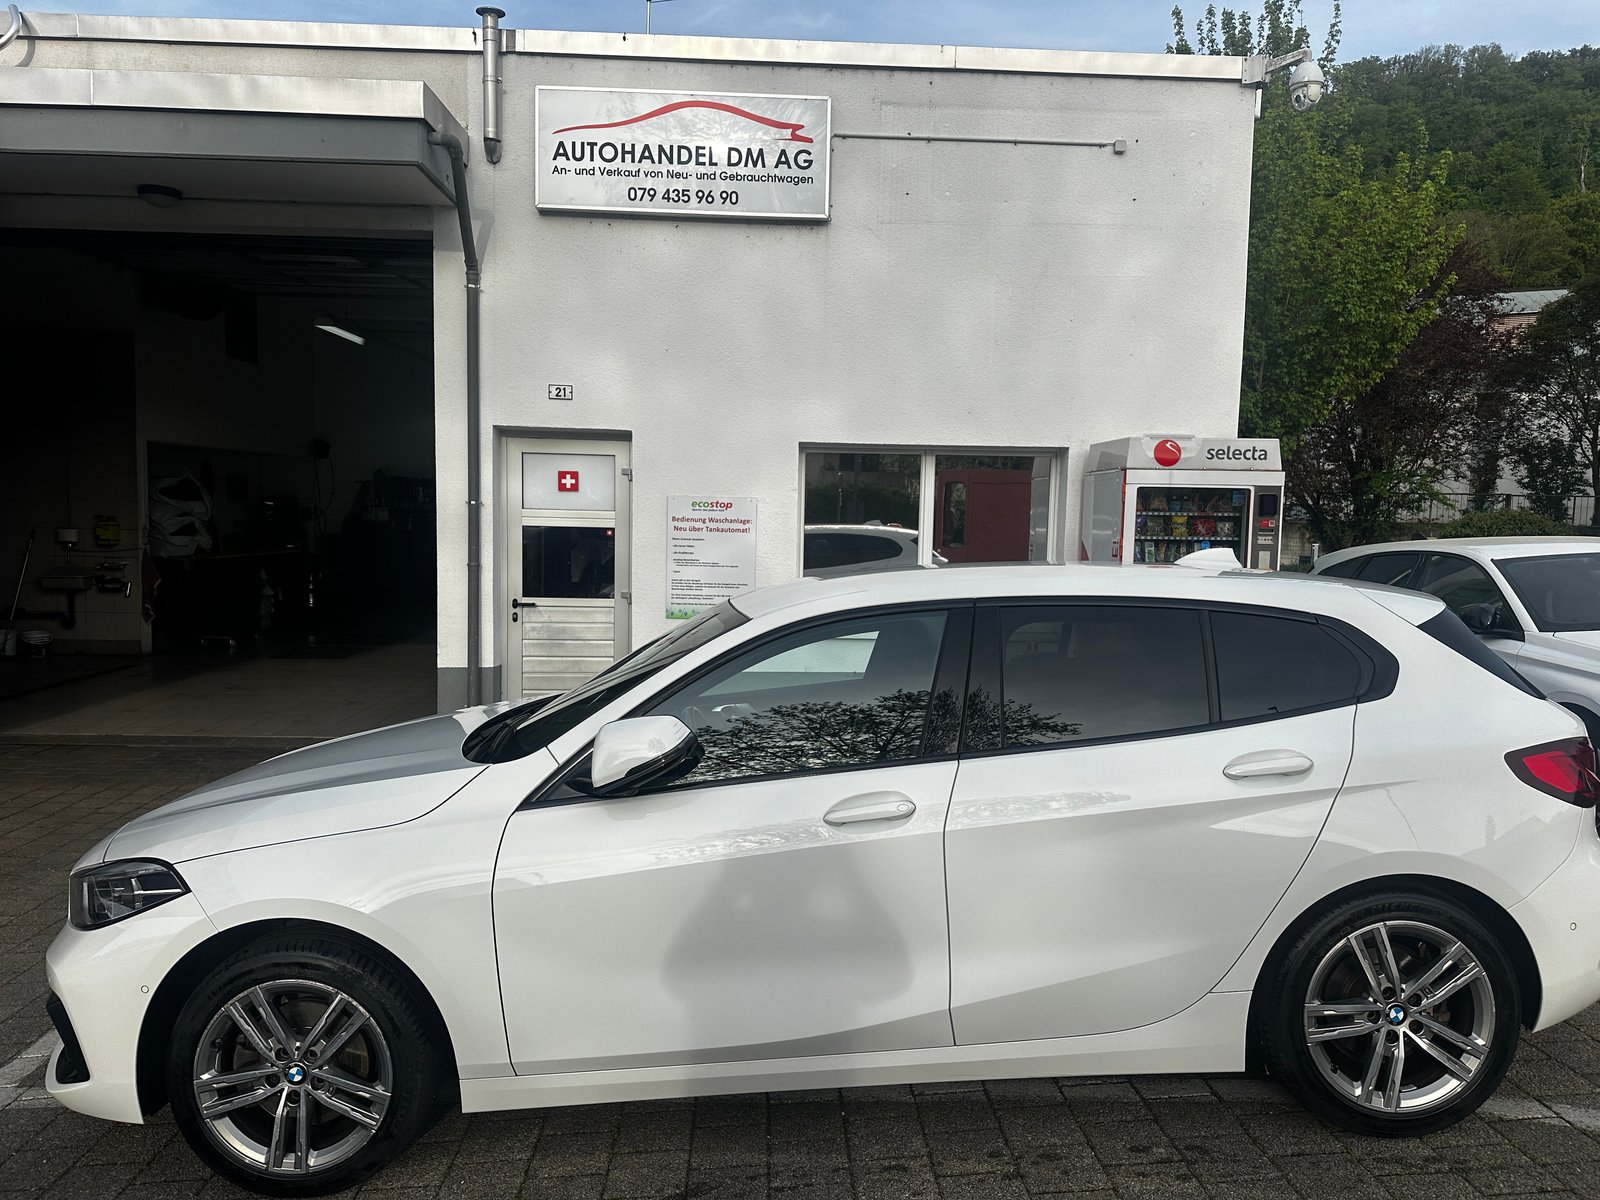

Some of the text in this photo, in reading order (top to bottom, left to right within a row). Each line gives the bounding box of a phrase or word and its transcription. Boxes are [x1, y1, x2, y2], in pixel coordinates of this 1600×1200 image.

[551, 140, 814, 171] AUTOHANDEL DM AG
[551, 164, 814, 187] An- und Verkauf von Neu- und Gebrauchtwagen
[627, 186, 739, 206] 079 435 96 90
[555, 386, 566, 398] 21
[1205, 445, 1268, 461] selecta
[691, 500, 733, 511] ecostop
[671, 515, 753, 526] Bedienung Waschanlage:
[705, 526, 751, 534] Tankautomat!
